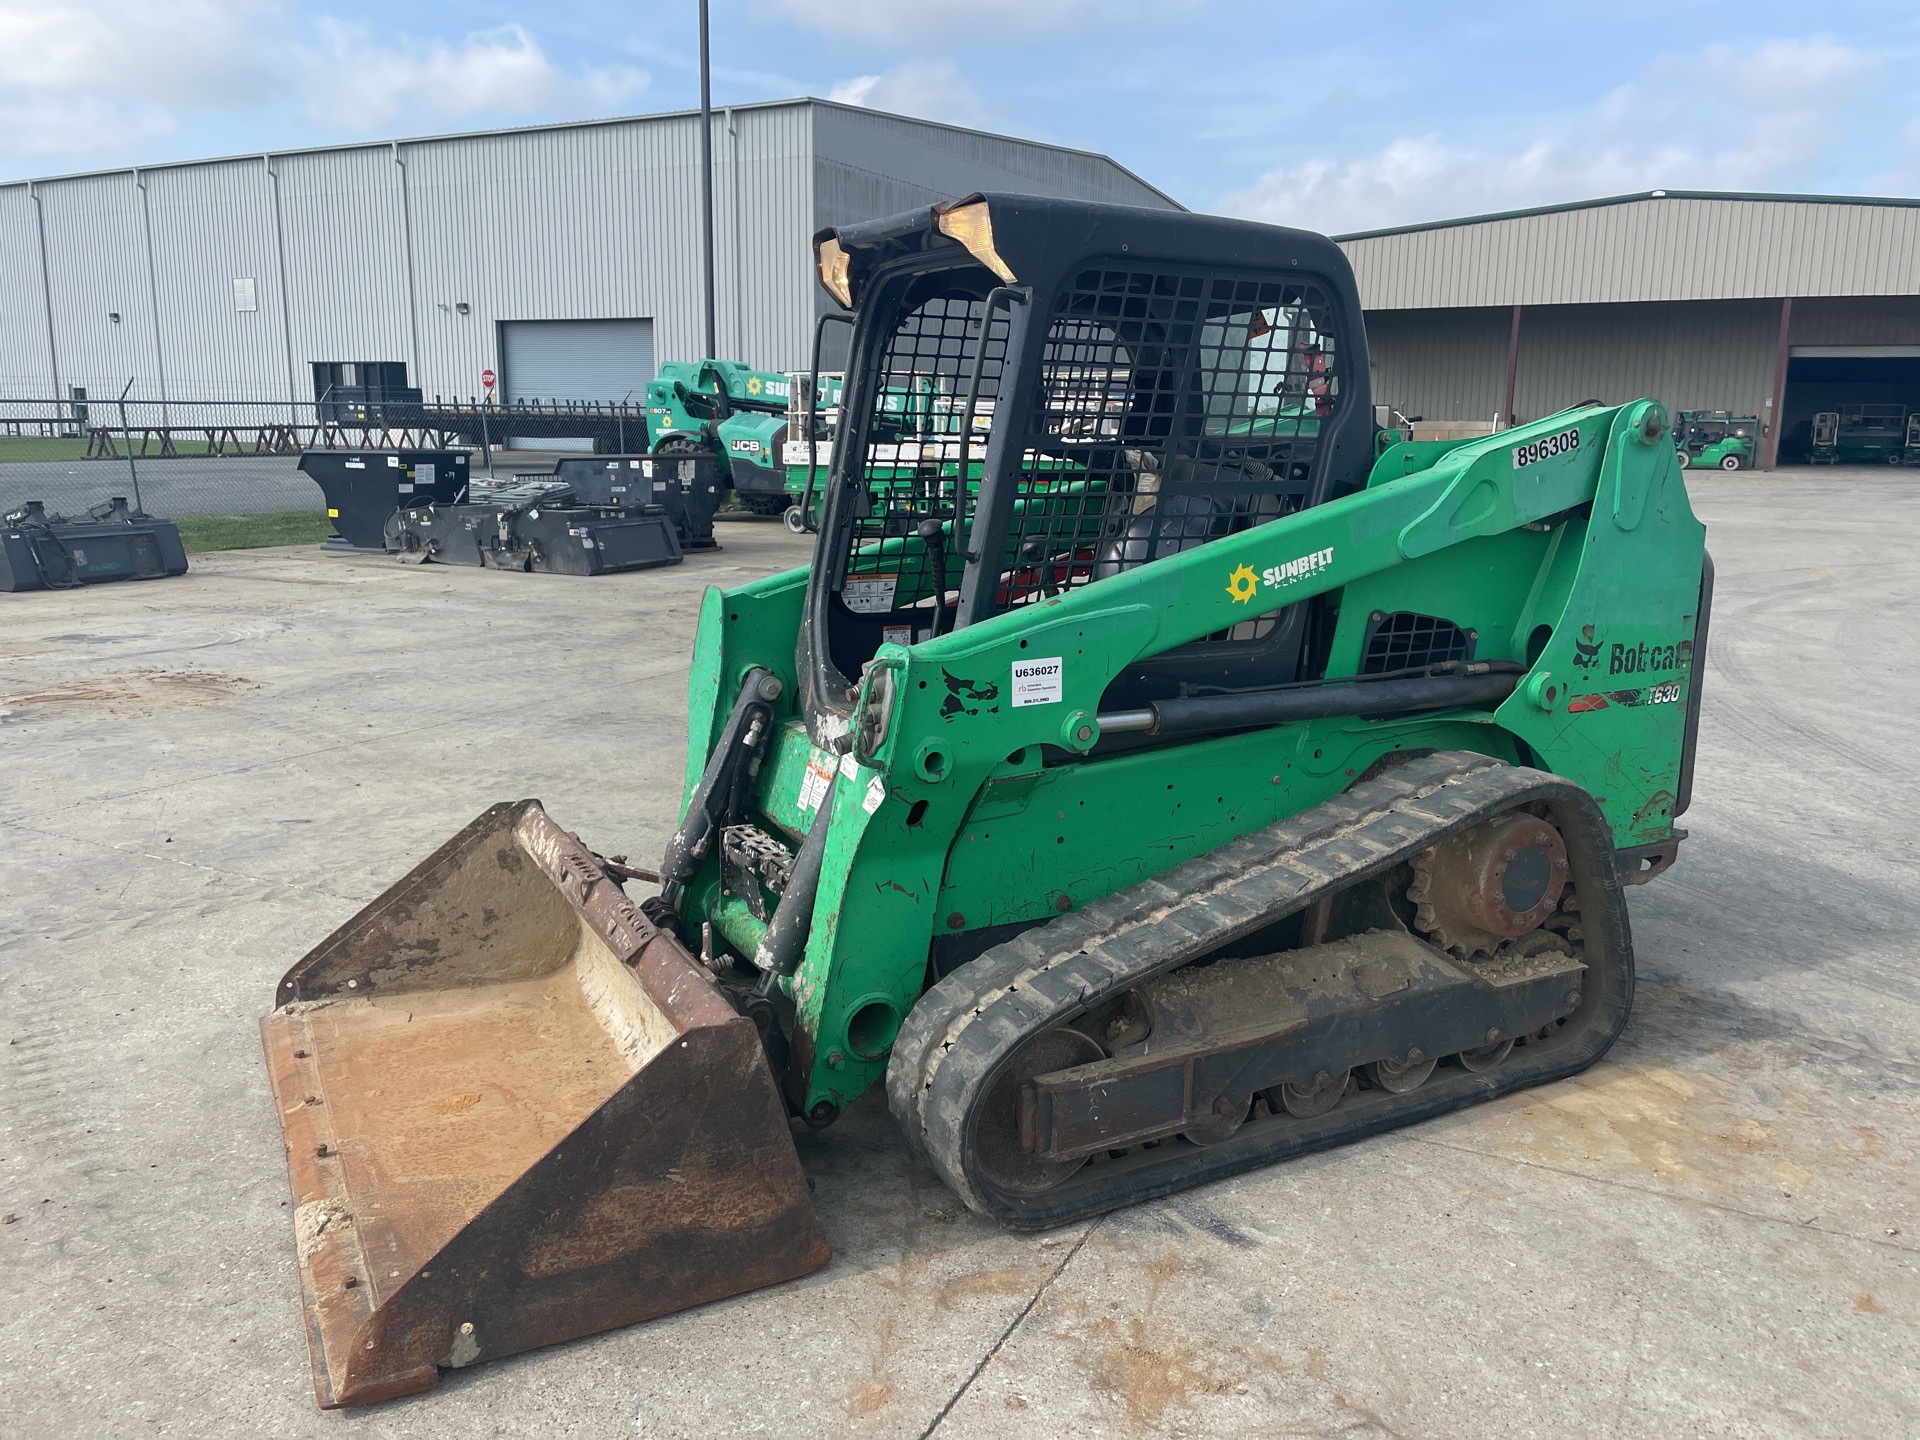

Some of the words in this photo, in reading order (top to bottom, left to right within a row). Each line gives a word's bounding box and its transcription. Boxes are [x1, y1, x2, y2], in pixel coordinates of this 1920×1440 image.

[482, 374, 495, 383] STOP
[732, 440, 760, 451] JCB
[1517, 429, 1580, 466] 896308
[1262, 546, 1334, 587] SUNBELT
[1015, 665, 1059, 678] U636027
[1647, 684, 1682, 705] T630
